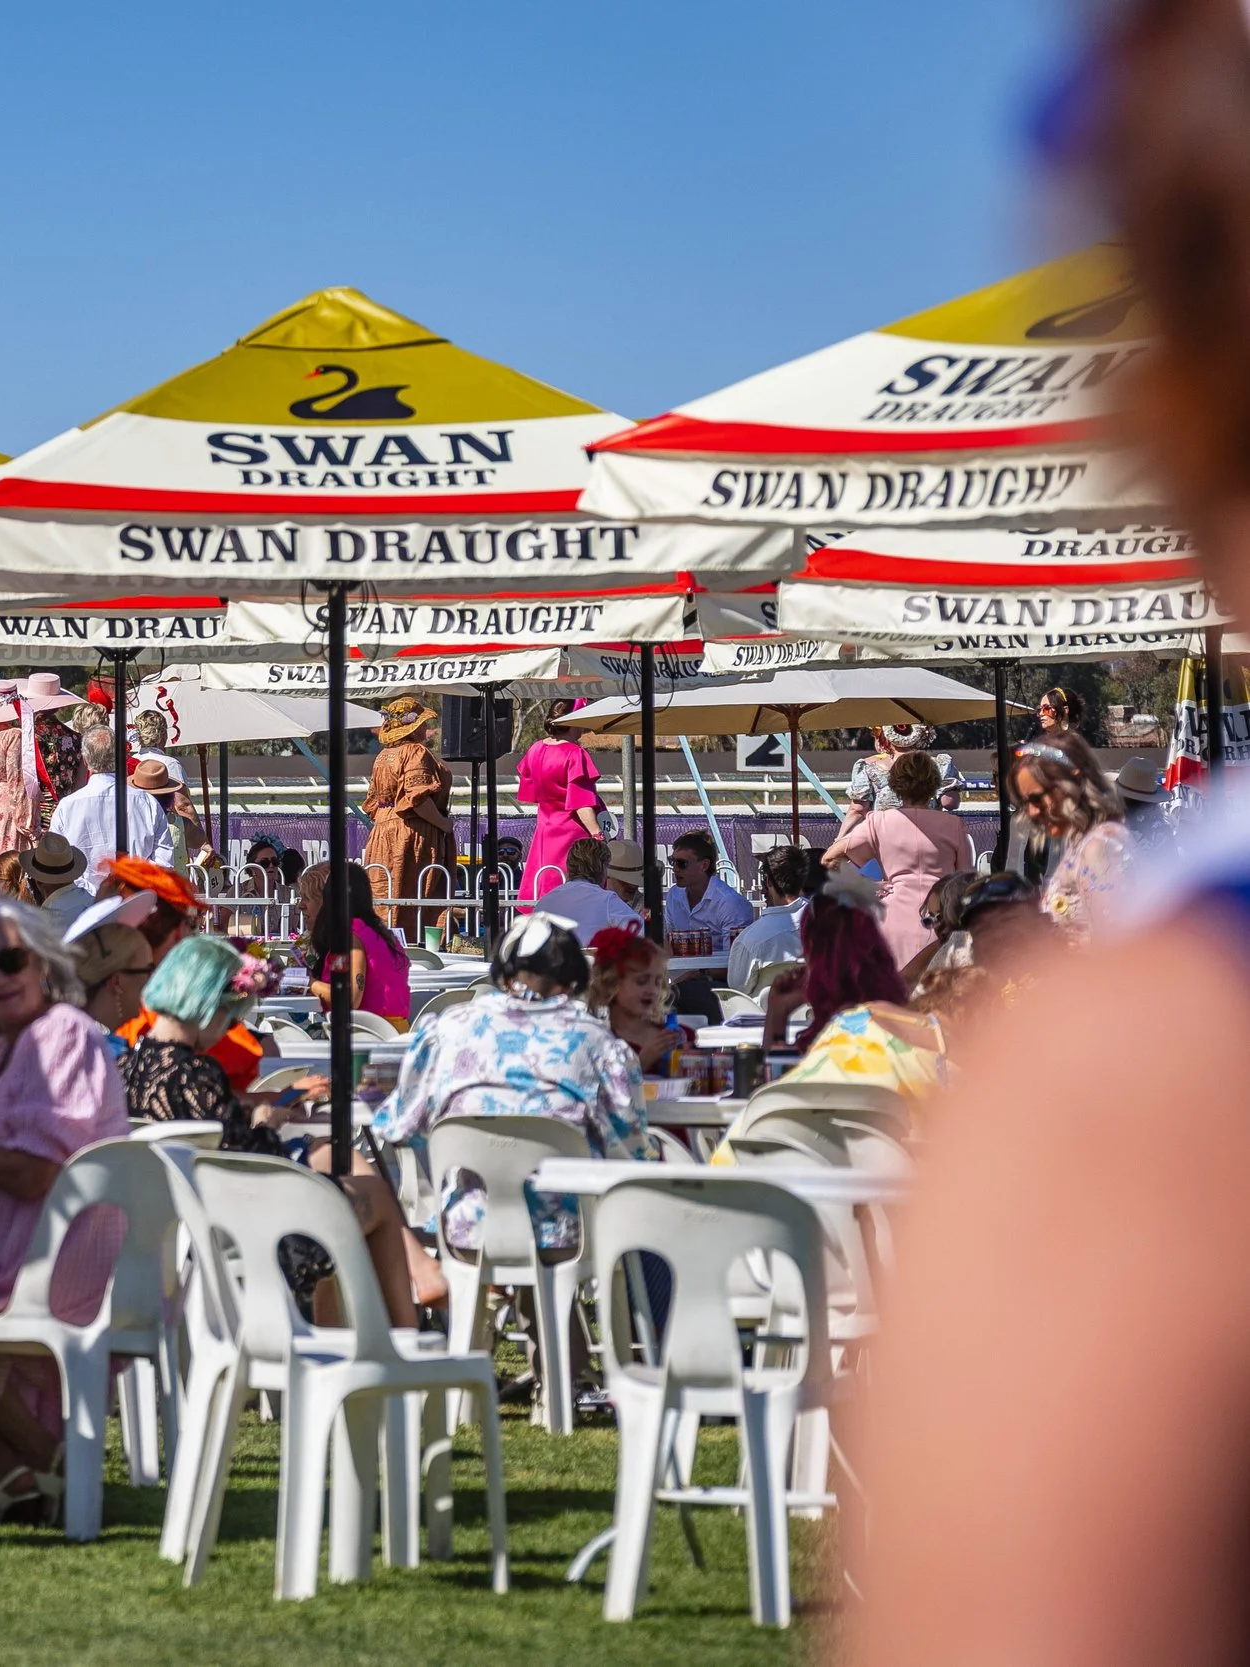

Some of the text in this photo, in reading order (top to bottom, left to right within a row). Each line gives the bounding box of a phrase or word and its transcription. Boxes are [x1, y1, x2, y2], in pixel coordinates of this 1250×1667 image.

[877, 353, 1150, 397] SWAN
[862, 396, 1068, 421] DRAUGHT
[207, 430, 514, 466] SWAN
[238, 469, 497, 488] DRAUGHT
[701, 462, 1088, 513] SWAN DRAUGHT
[119, 523, 639, 564] SWAN DRAUGHT
[376, 605, 603, 636] DRAUGHT
[902, 595, 1052, 627] SWAN
[106, 616, 223, 639] DRAU
[732, 645, 775, 666] SWAN
[268, 660, 496, 684] SWA DRAUGHT
[745, 734, 785, 767] 2
[603, 820, 611, 832] 13
